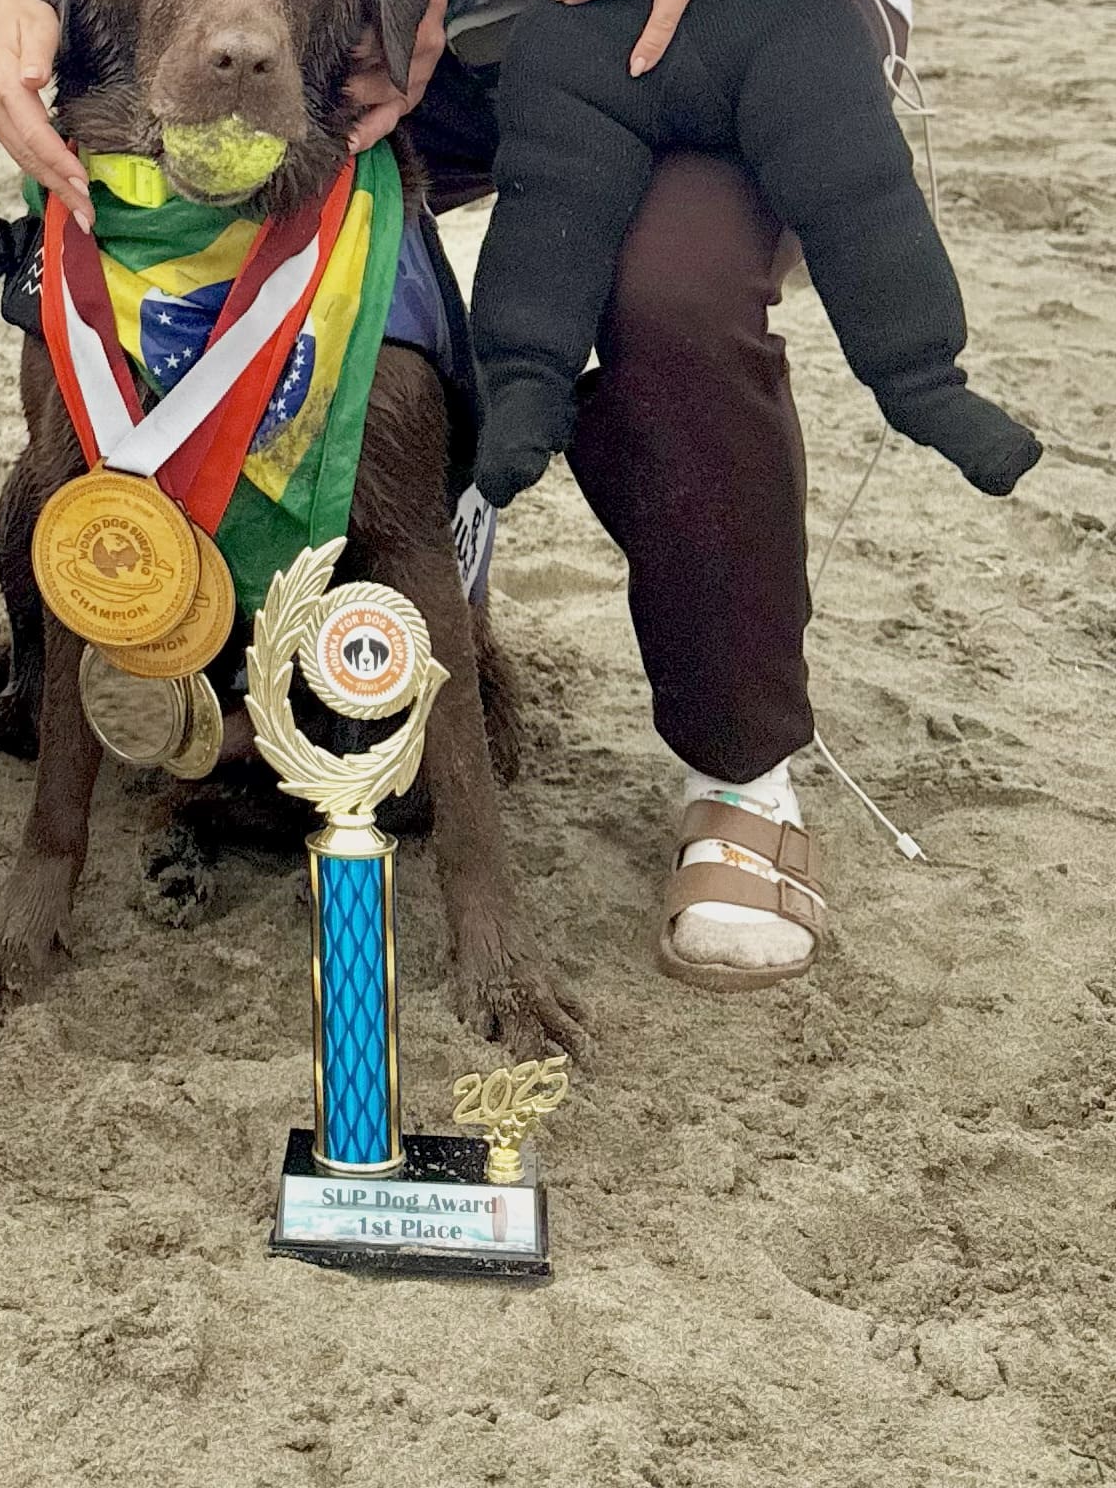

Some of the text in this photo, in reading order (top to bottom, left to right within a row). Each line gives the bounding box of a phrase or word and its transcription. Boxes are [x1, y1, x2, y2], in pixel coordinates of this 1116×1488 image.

[78, 517, 154, 576] WORLD DOG SURFING
[70, 588, 150, 621] CHAMPION
[328, 612, 406, 675] VODKA FOR DOG PEOPLE
[452, 1053, 570, 1125] 2025
[322, 1187, 498, 1214] SUP Dog Award
[358, 1216, 463, 1241] 1st Place
